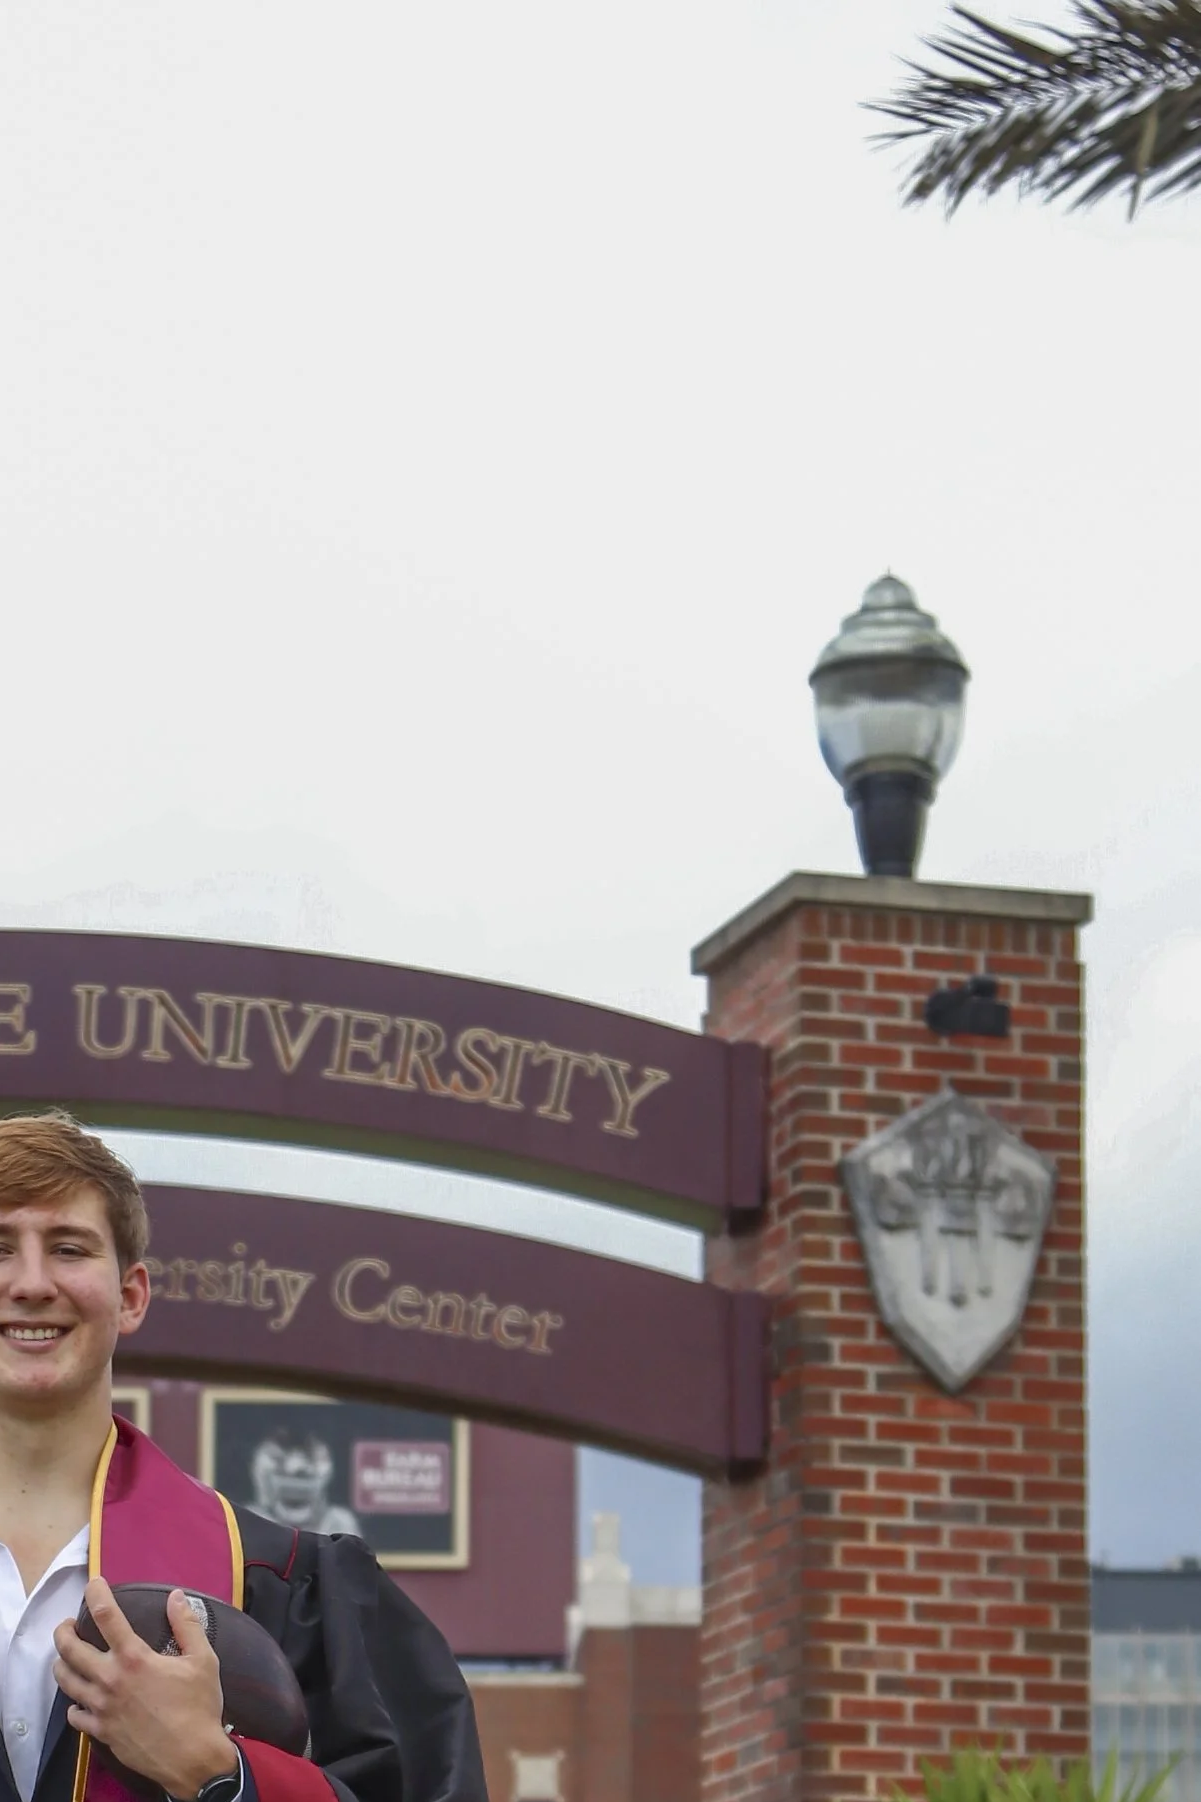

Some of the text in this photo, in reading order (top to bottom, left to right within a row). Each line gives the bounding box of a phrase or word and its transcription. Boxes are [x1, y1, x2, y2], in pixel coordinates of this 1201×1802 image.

[75, 984, 671, 1139] UNIVERSITY
[140, 1242, 315, 1331] ersity
[334, 1257, 563, 1355] Center
